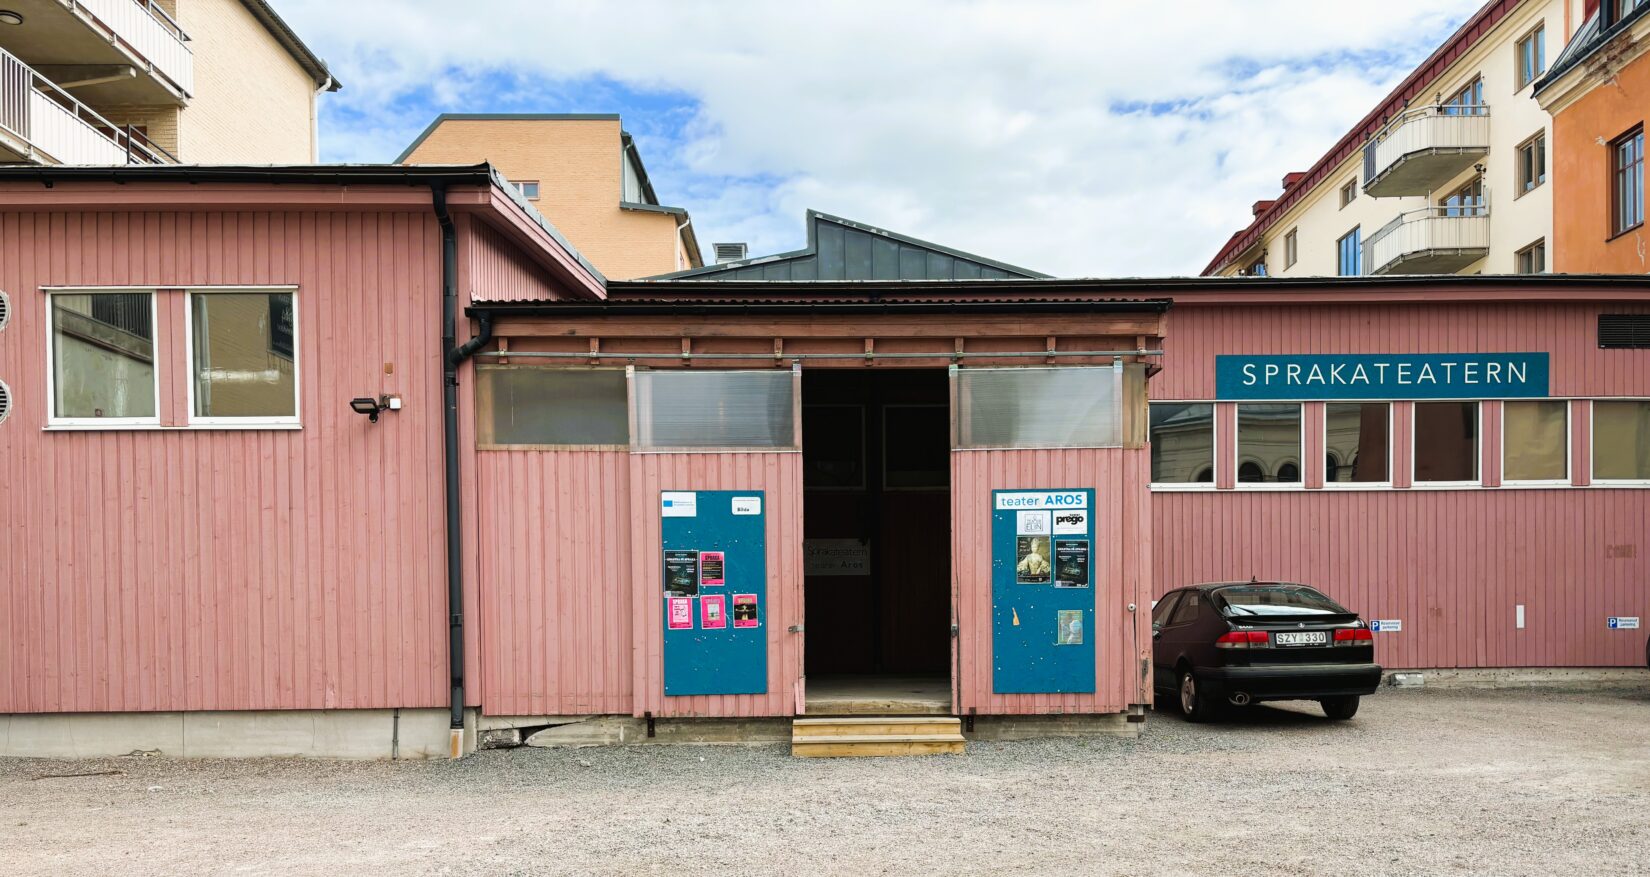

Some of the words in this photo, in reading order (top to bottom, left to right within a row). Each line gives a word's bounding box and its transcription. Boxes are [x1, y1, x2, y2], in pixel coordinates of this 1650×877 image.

[1242, 362, 1527, 385] SPRAKATEATERN
[1001, 496, 1039, 506] teater
[1045, 494, 1083, 505] AROS
[1056, 515, 1084, 525] prego
[840, 560, 864, 569] Aros
[1277, 633, 1298, 643] SZY
[1305, 633, 1325, 642] 330
